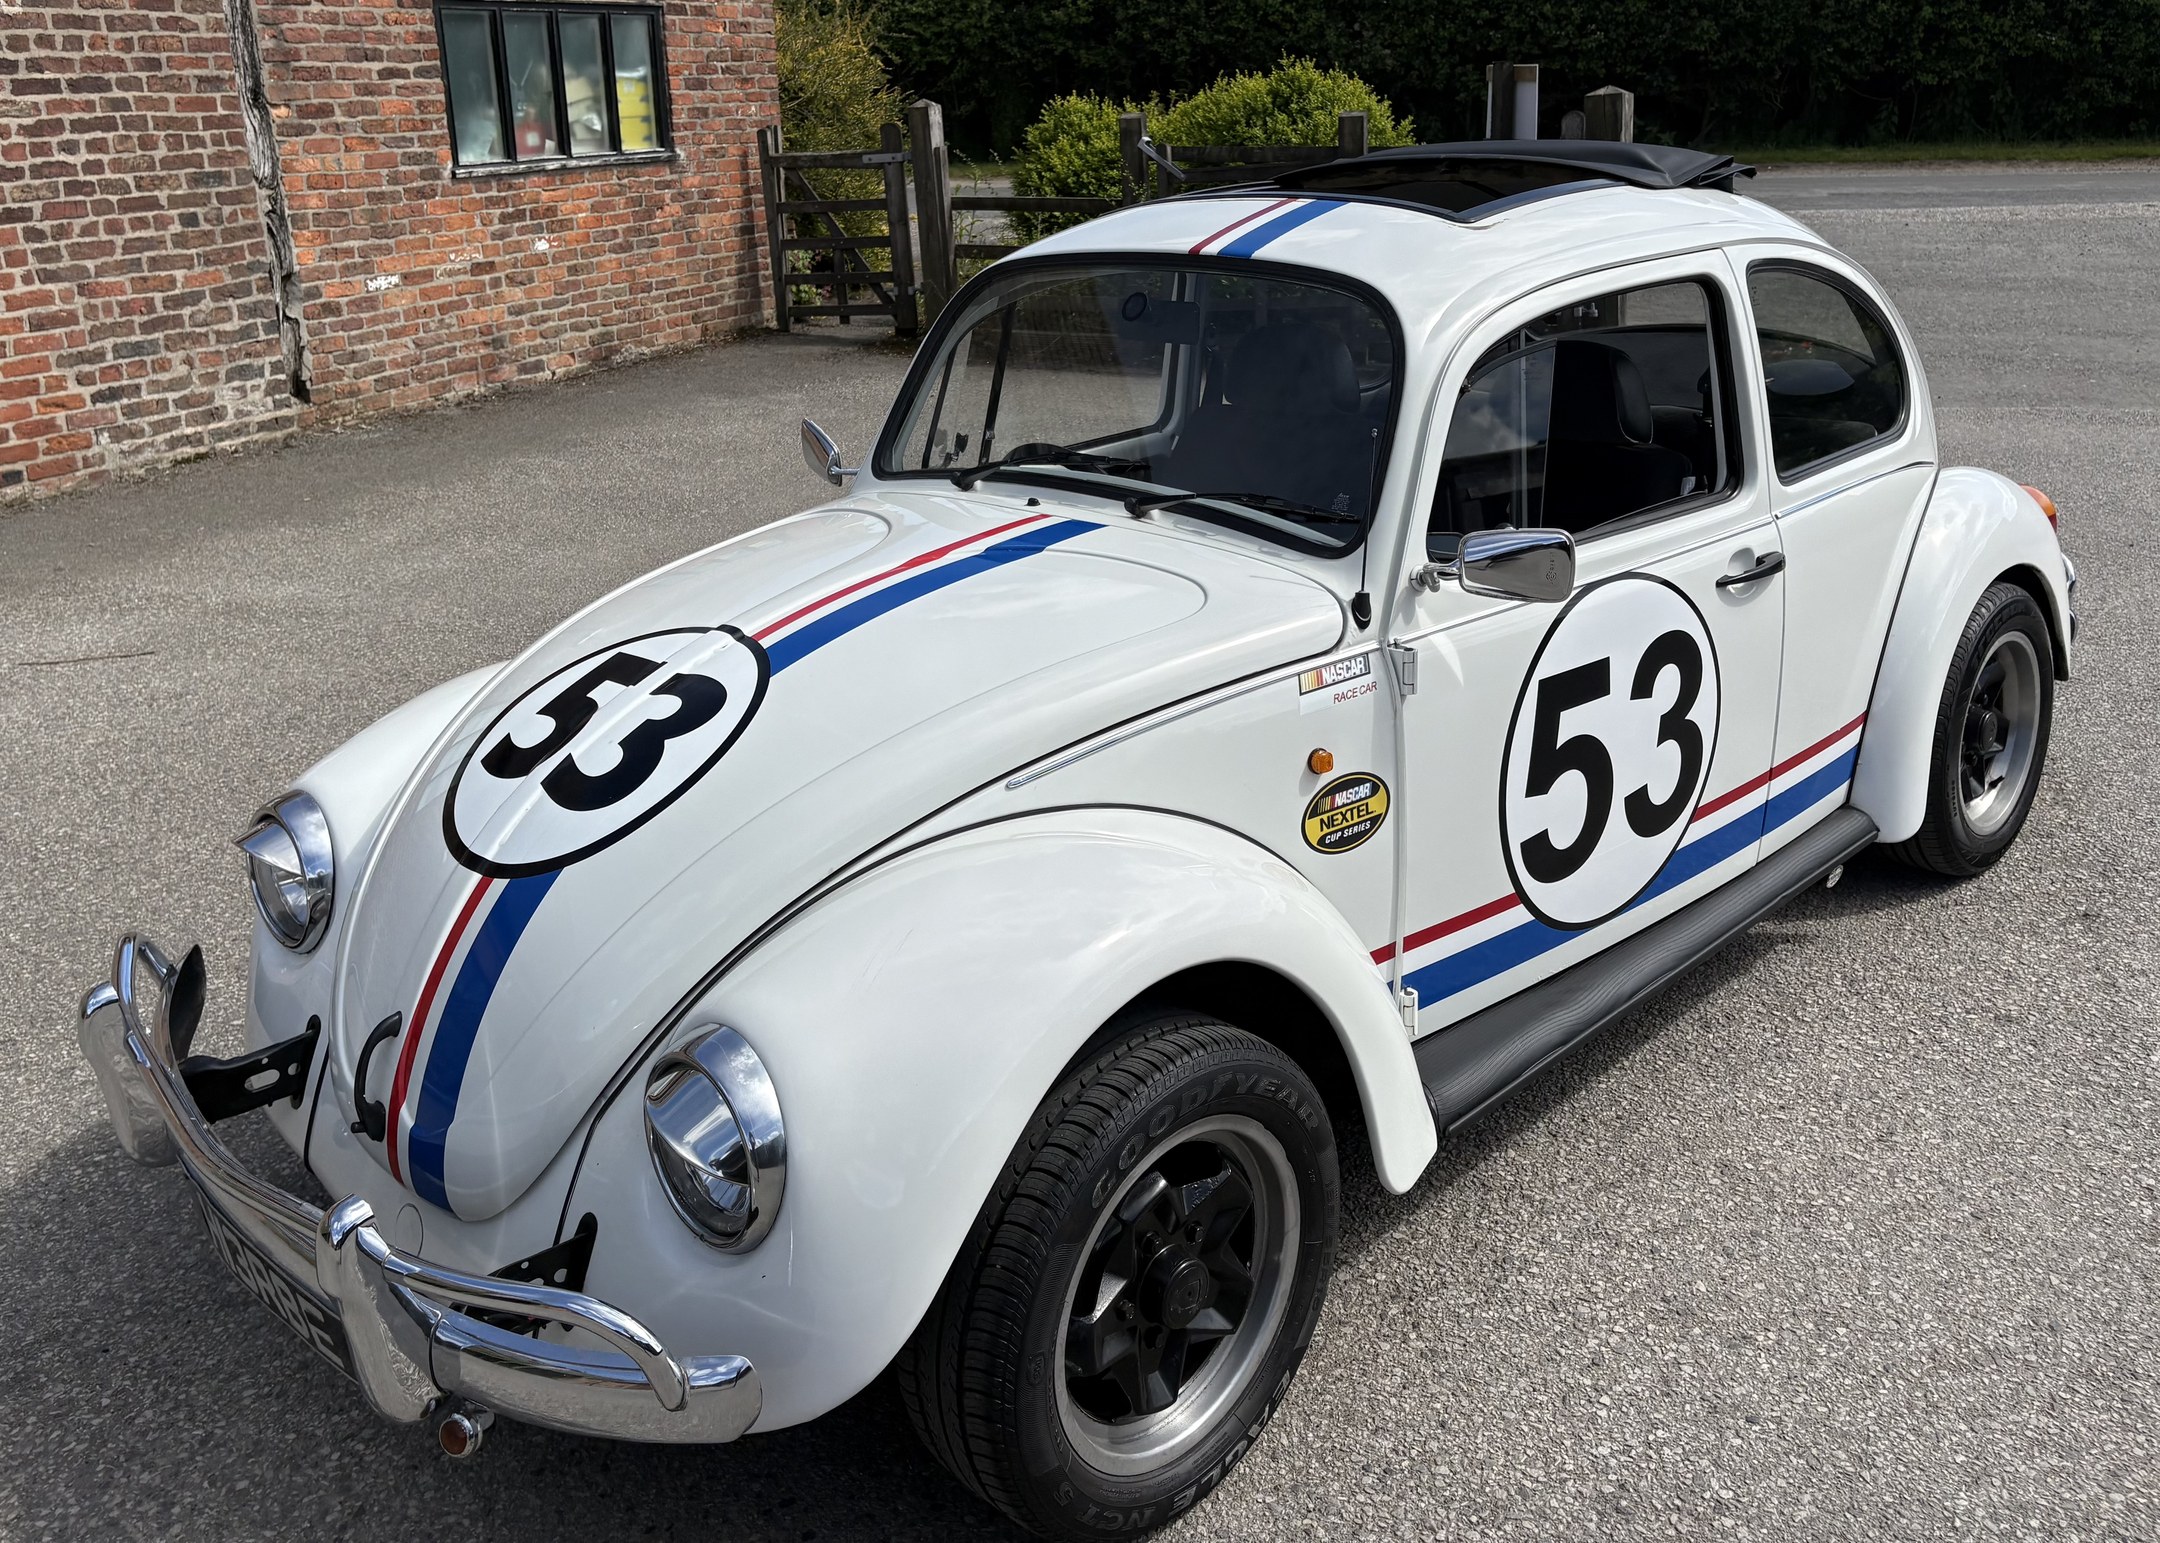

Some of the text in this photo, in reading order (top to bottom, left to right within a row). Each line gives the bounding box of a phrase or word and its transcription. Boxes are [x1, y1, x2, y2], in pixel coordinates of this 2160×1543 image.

[1321, 656, 1366, 685] NASCAR
[1333, 681, 1378, 704] RACE CAR
[480, 651, 728, 812] 53
[1520, 629, 1704, 884] 53
[1334, 782, 1372, 808] NASCAR
[1319, 801, 1374, 832] NEXTEL
[1325, 820, 1371, 844] CUP SERIES
[1168, 1370, 1290, 1518] EAGLE
[1075, 1502, 1156, 1531] NCT
